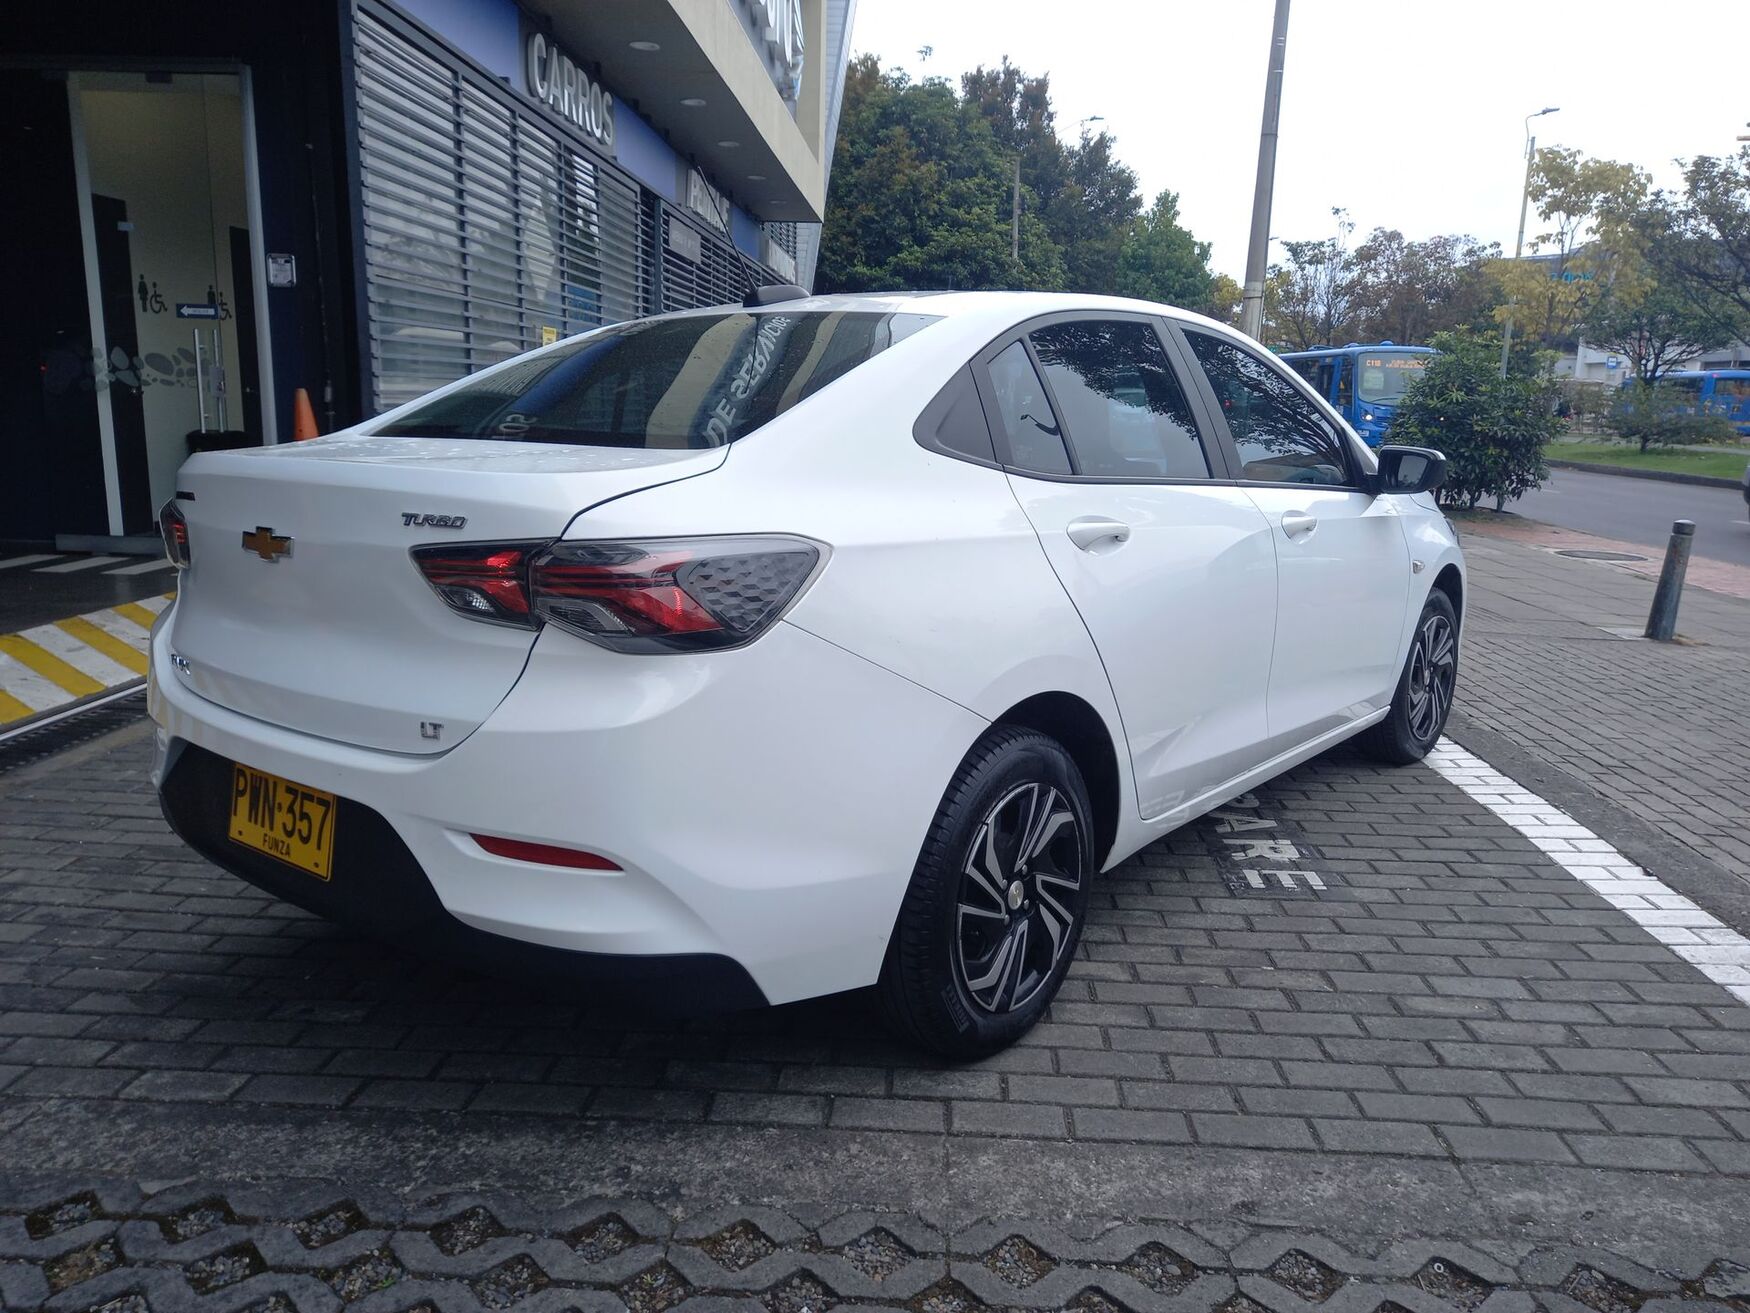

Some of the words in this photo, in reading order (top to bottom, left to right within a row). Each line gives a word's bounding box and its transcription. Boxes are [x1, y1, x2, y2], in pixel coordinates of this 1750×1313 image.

[530, 33, 613, 146] CARROS
[401, 512, 468, 529] TURBO
[420, 721, 444, 740] LT
[262, 833, 291, 857] FUNZA
